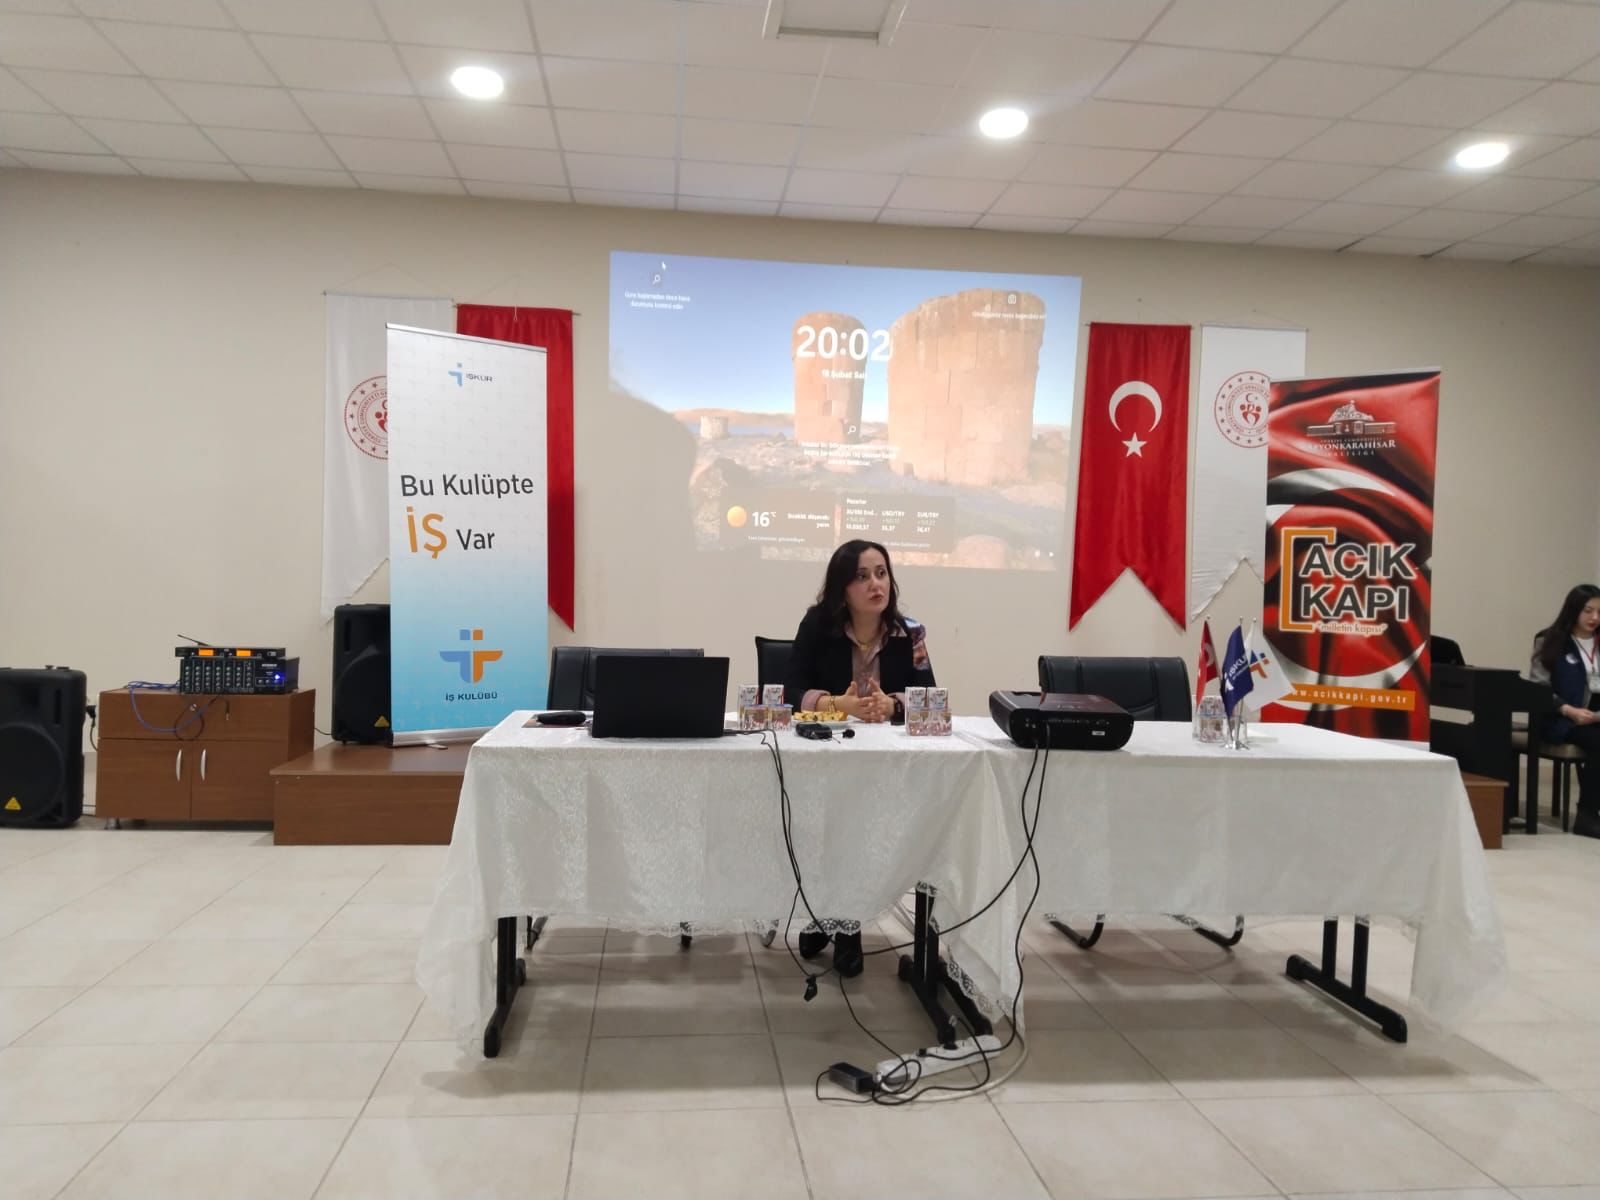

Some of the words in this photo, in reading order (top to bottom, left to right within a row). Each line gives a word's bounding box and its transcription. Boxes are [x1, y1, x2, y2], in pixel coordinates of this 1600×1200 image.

[796, 325, 893, 361] 20:02
[1310, 439, 1396, 450] YONKARAHİSAR
[400, 475, 434, 497] Bu
[442, 473, 534, 499] Kulüpte
[406, 506, 448, 559] İŞ
[456, 529, 495, 550] Var
[1299, 543, 1417, 581] AÇIK
[1301, 584, 1409, 622] KAPI
[457, 691, 498, 701] KULÜBÜ
[1292, 688, 1407, 704] ww.acikkapi.gov.tr
